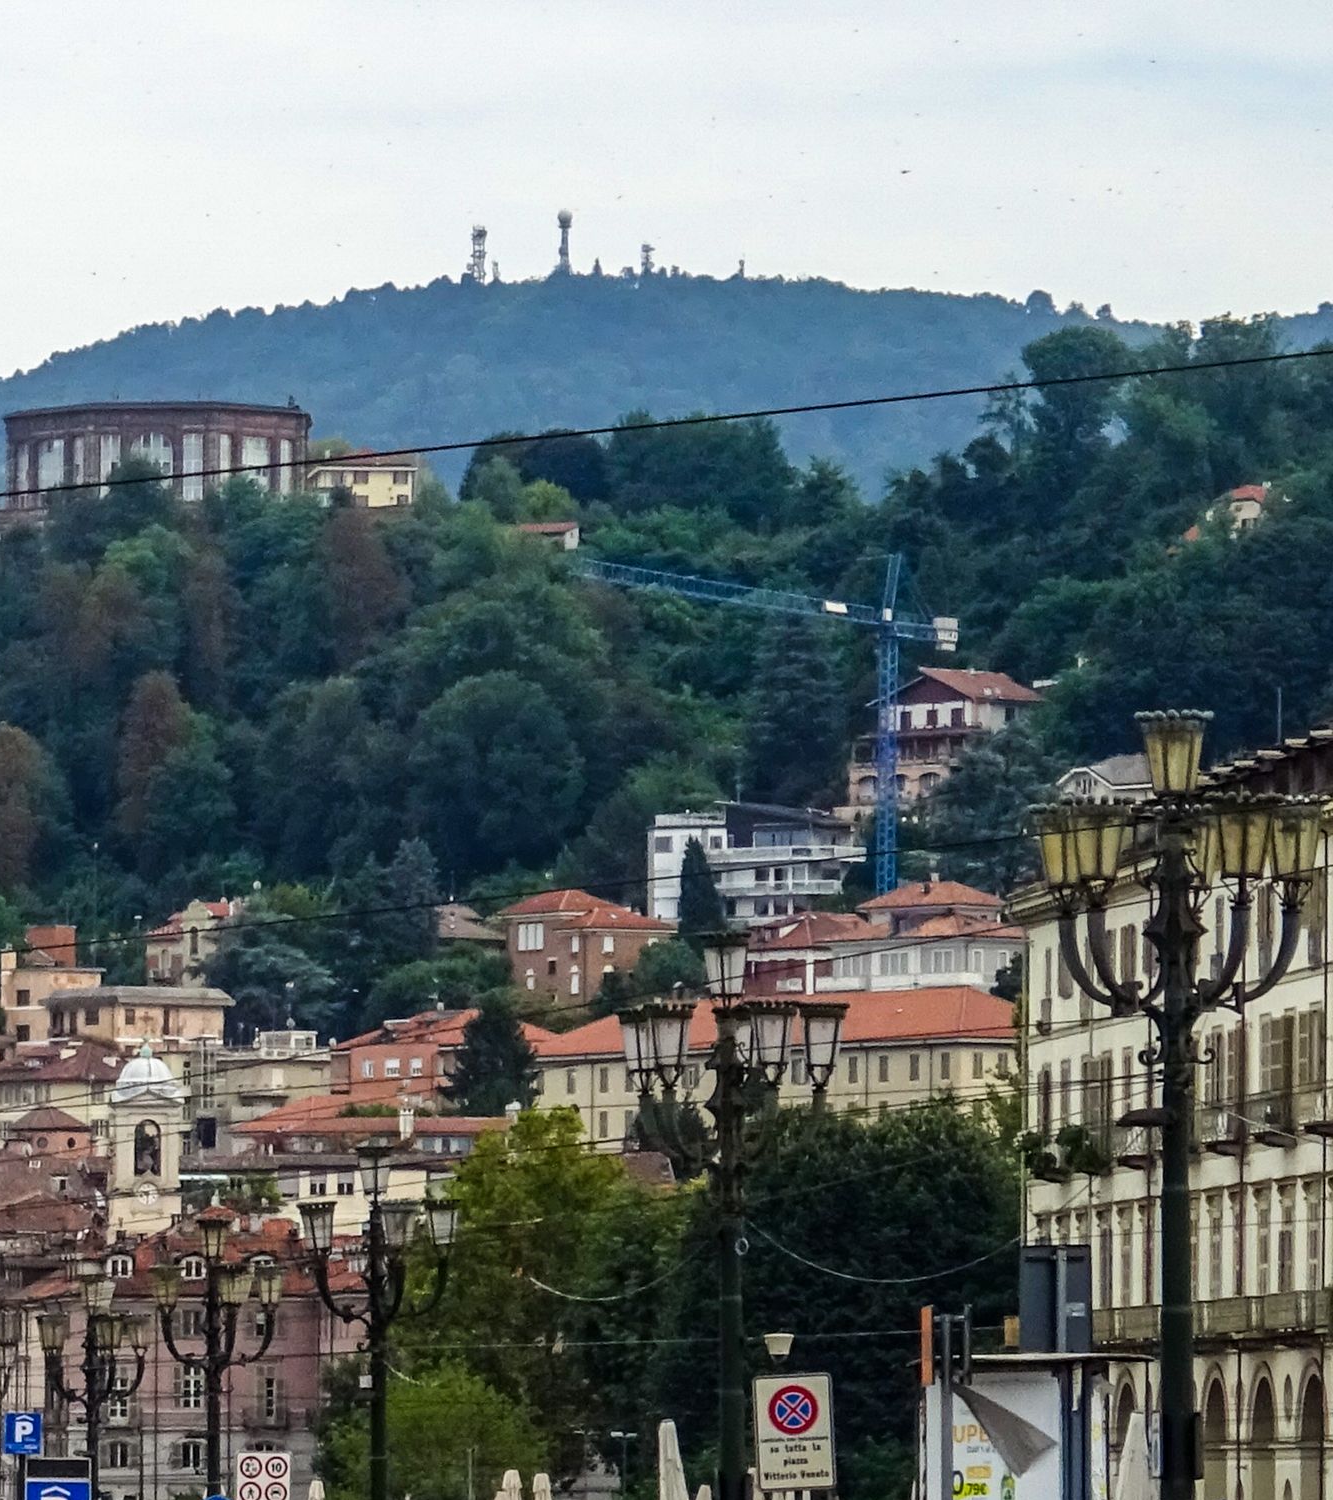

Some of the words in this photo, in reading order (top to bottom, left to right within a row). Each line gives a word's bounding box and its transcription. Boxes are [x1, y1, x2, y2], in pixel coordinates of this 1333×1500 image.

[14, 1420, 34, 1443] P
[271, 1462, 282, 1473] 10
[783, 1457, 809, 1467] piazza
[764, 1471, 797, 1480] Vittorio
[800, 1469, 830, 1479] Veneto
